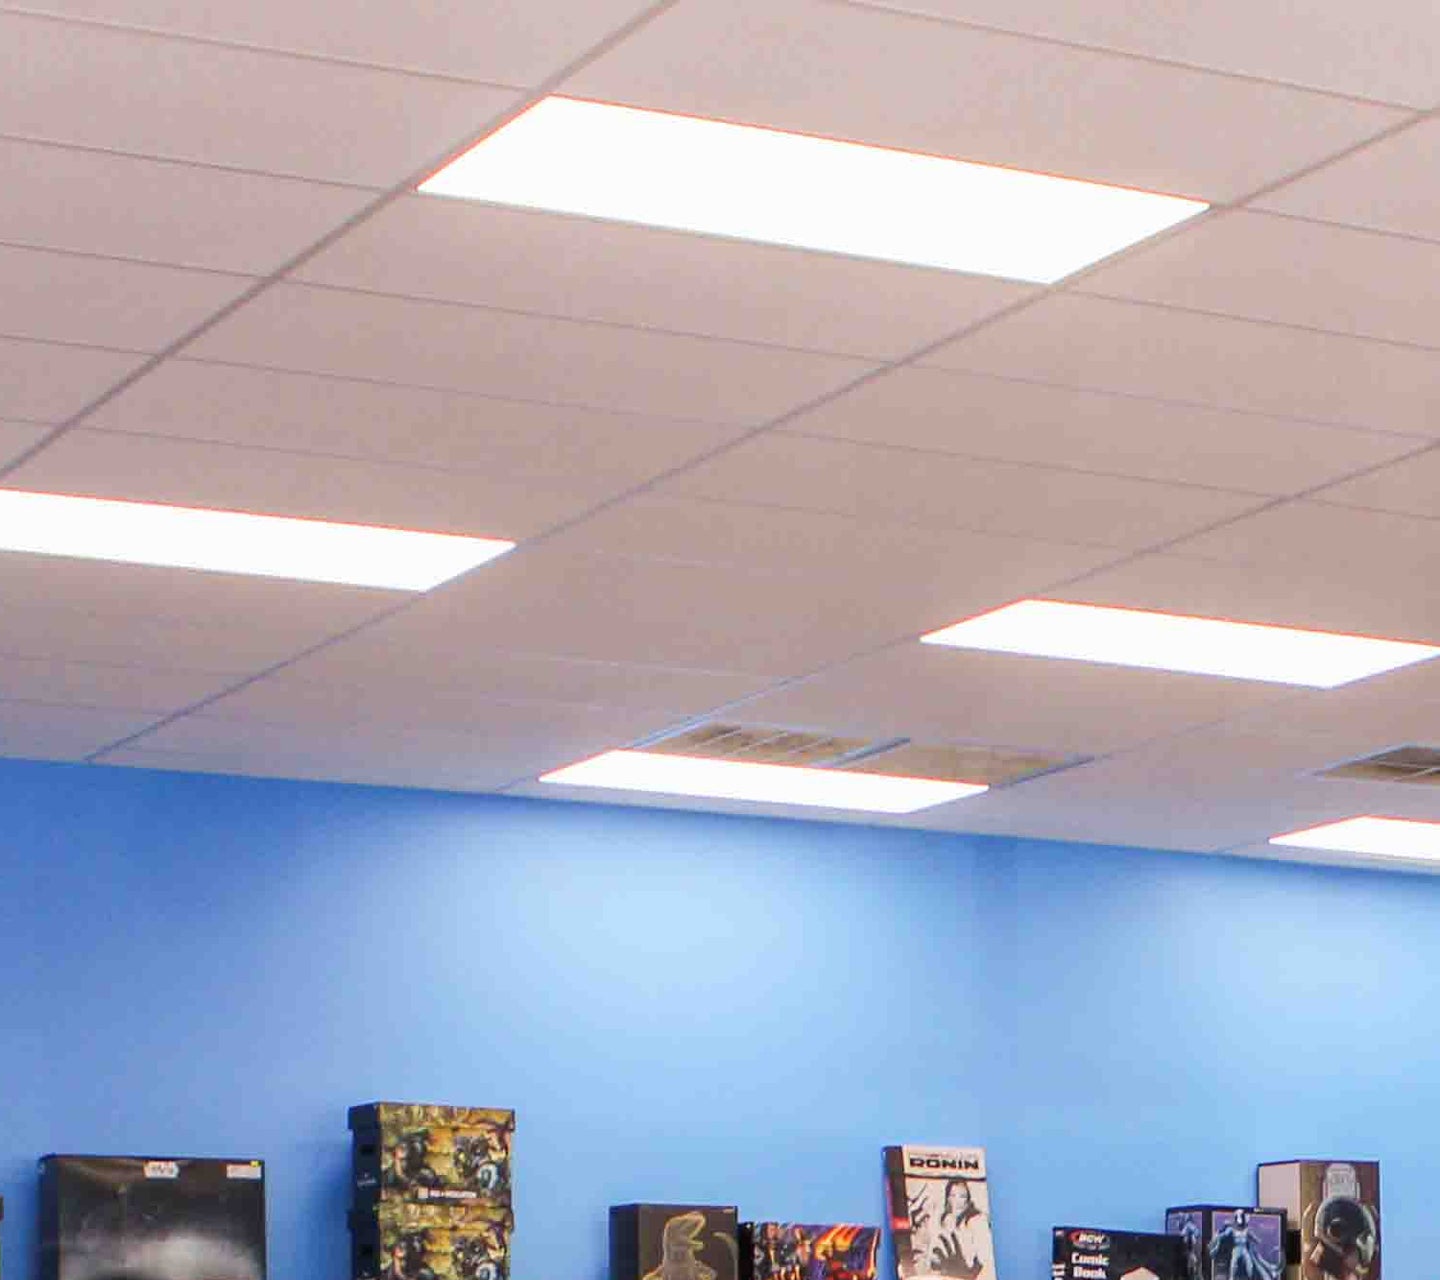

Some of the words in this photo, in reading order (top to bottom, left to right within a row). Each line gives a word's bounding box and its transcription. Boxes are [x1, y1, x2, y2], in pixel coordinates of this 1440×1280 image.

[909, 1157, 979, 1171] RONIN
[1070, 1252, 1110, 1266] Comic
[1073, 1266, 1108, 1280] Book
